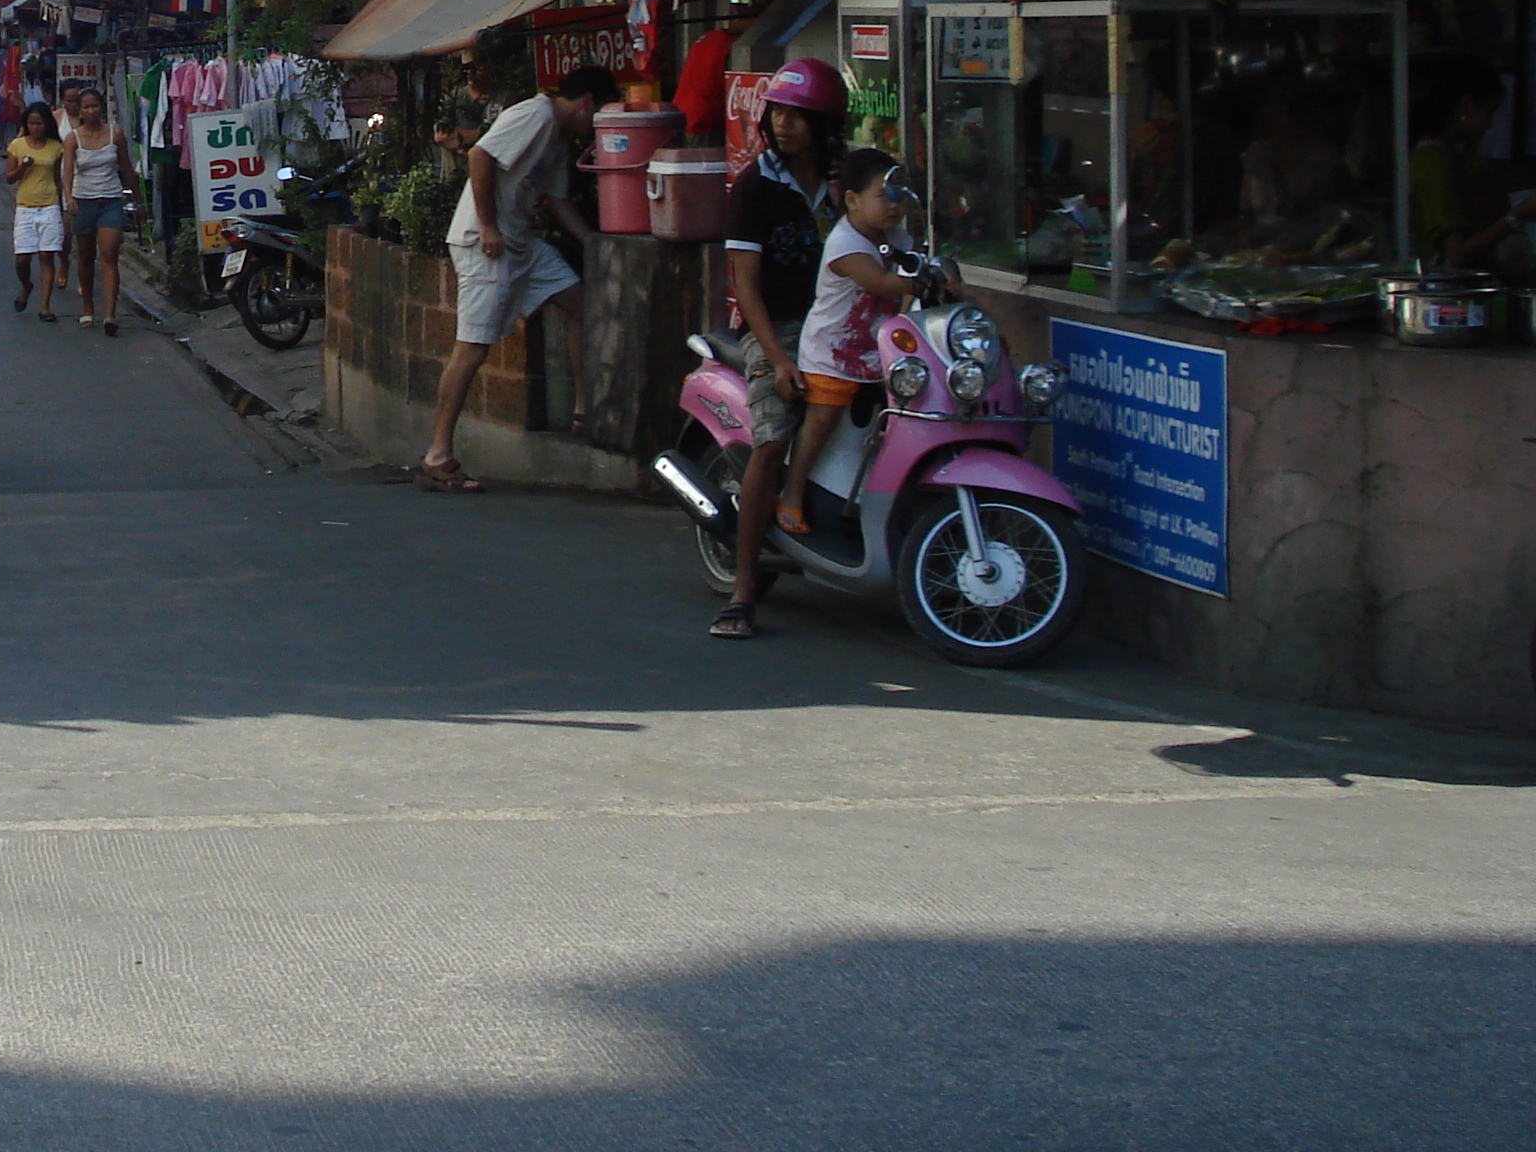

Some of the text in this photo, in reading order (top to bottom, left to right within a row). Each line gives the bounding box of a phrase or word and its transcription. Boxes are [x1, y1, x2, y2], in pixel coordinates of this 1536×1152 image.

[210, 184, 268, 211] รีด
[1115, 403, 1220, 461] ACUPUNCTURIST
[1155, 469, 1206, 503] Intersection
